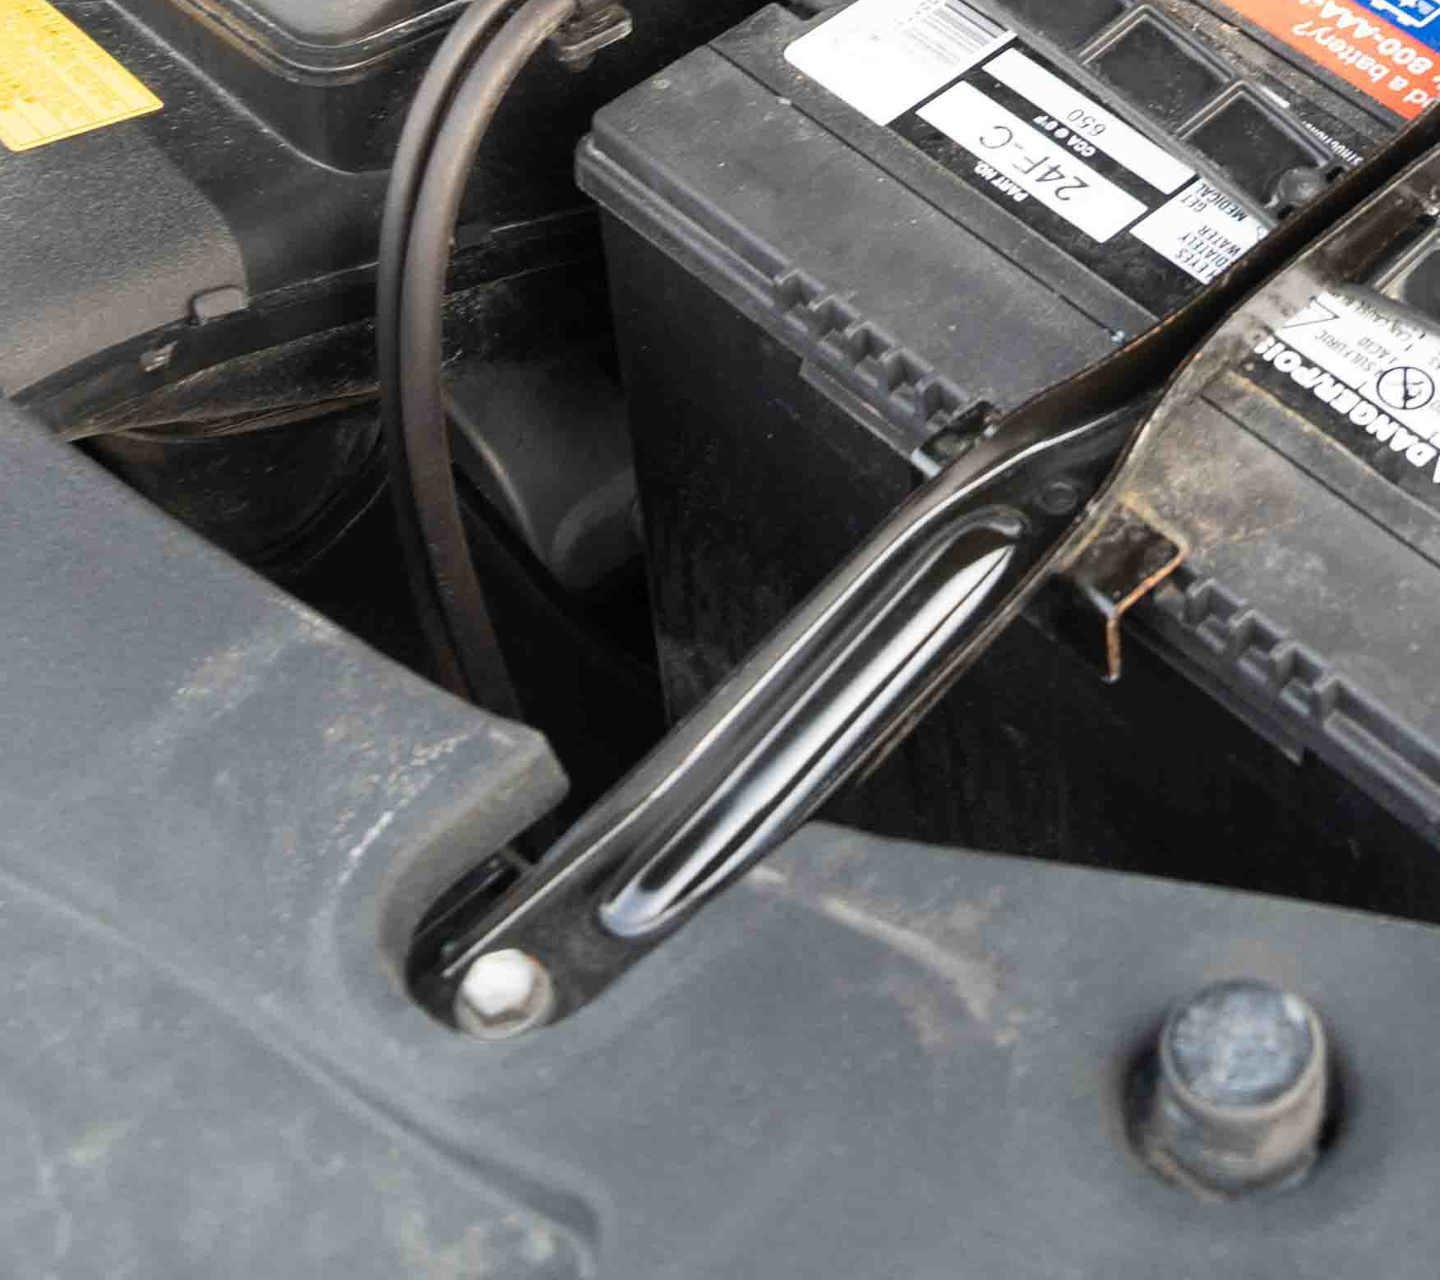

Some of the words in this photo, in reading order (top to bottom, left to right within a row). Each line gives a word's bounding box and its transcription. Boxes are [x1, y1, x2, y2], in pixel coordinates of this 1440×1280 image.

[1291, 11, 1392, 84] battery?
[1066, 107, 1107, 137] 650
[1066, 133, 1097, 158] CCA
[976, 120, 1090, 203] 24F-C
[990, 174, 1029, 203] PART
[1180, 193, 1207, 214] GET
[1195, 183, 1248, 222] MEDICAL
[1178, 231, 1230, 269] DIATELY
[1197, 225, 1241, 257] WATER
[1174, 247, 1208, 275] EYES
[1313, 326, 1377, 374] SULFURIC
[1354, 334, 1391, 361] ACID
